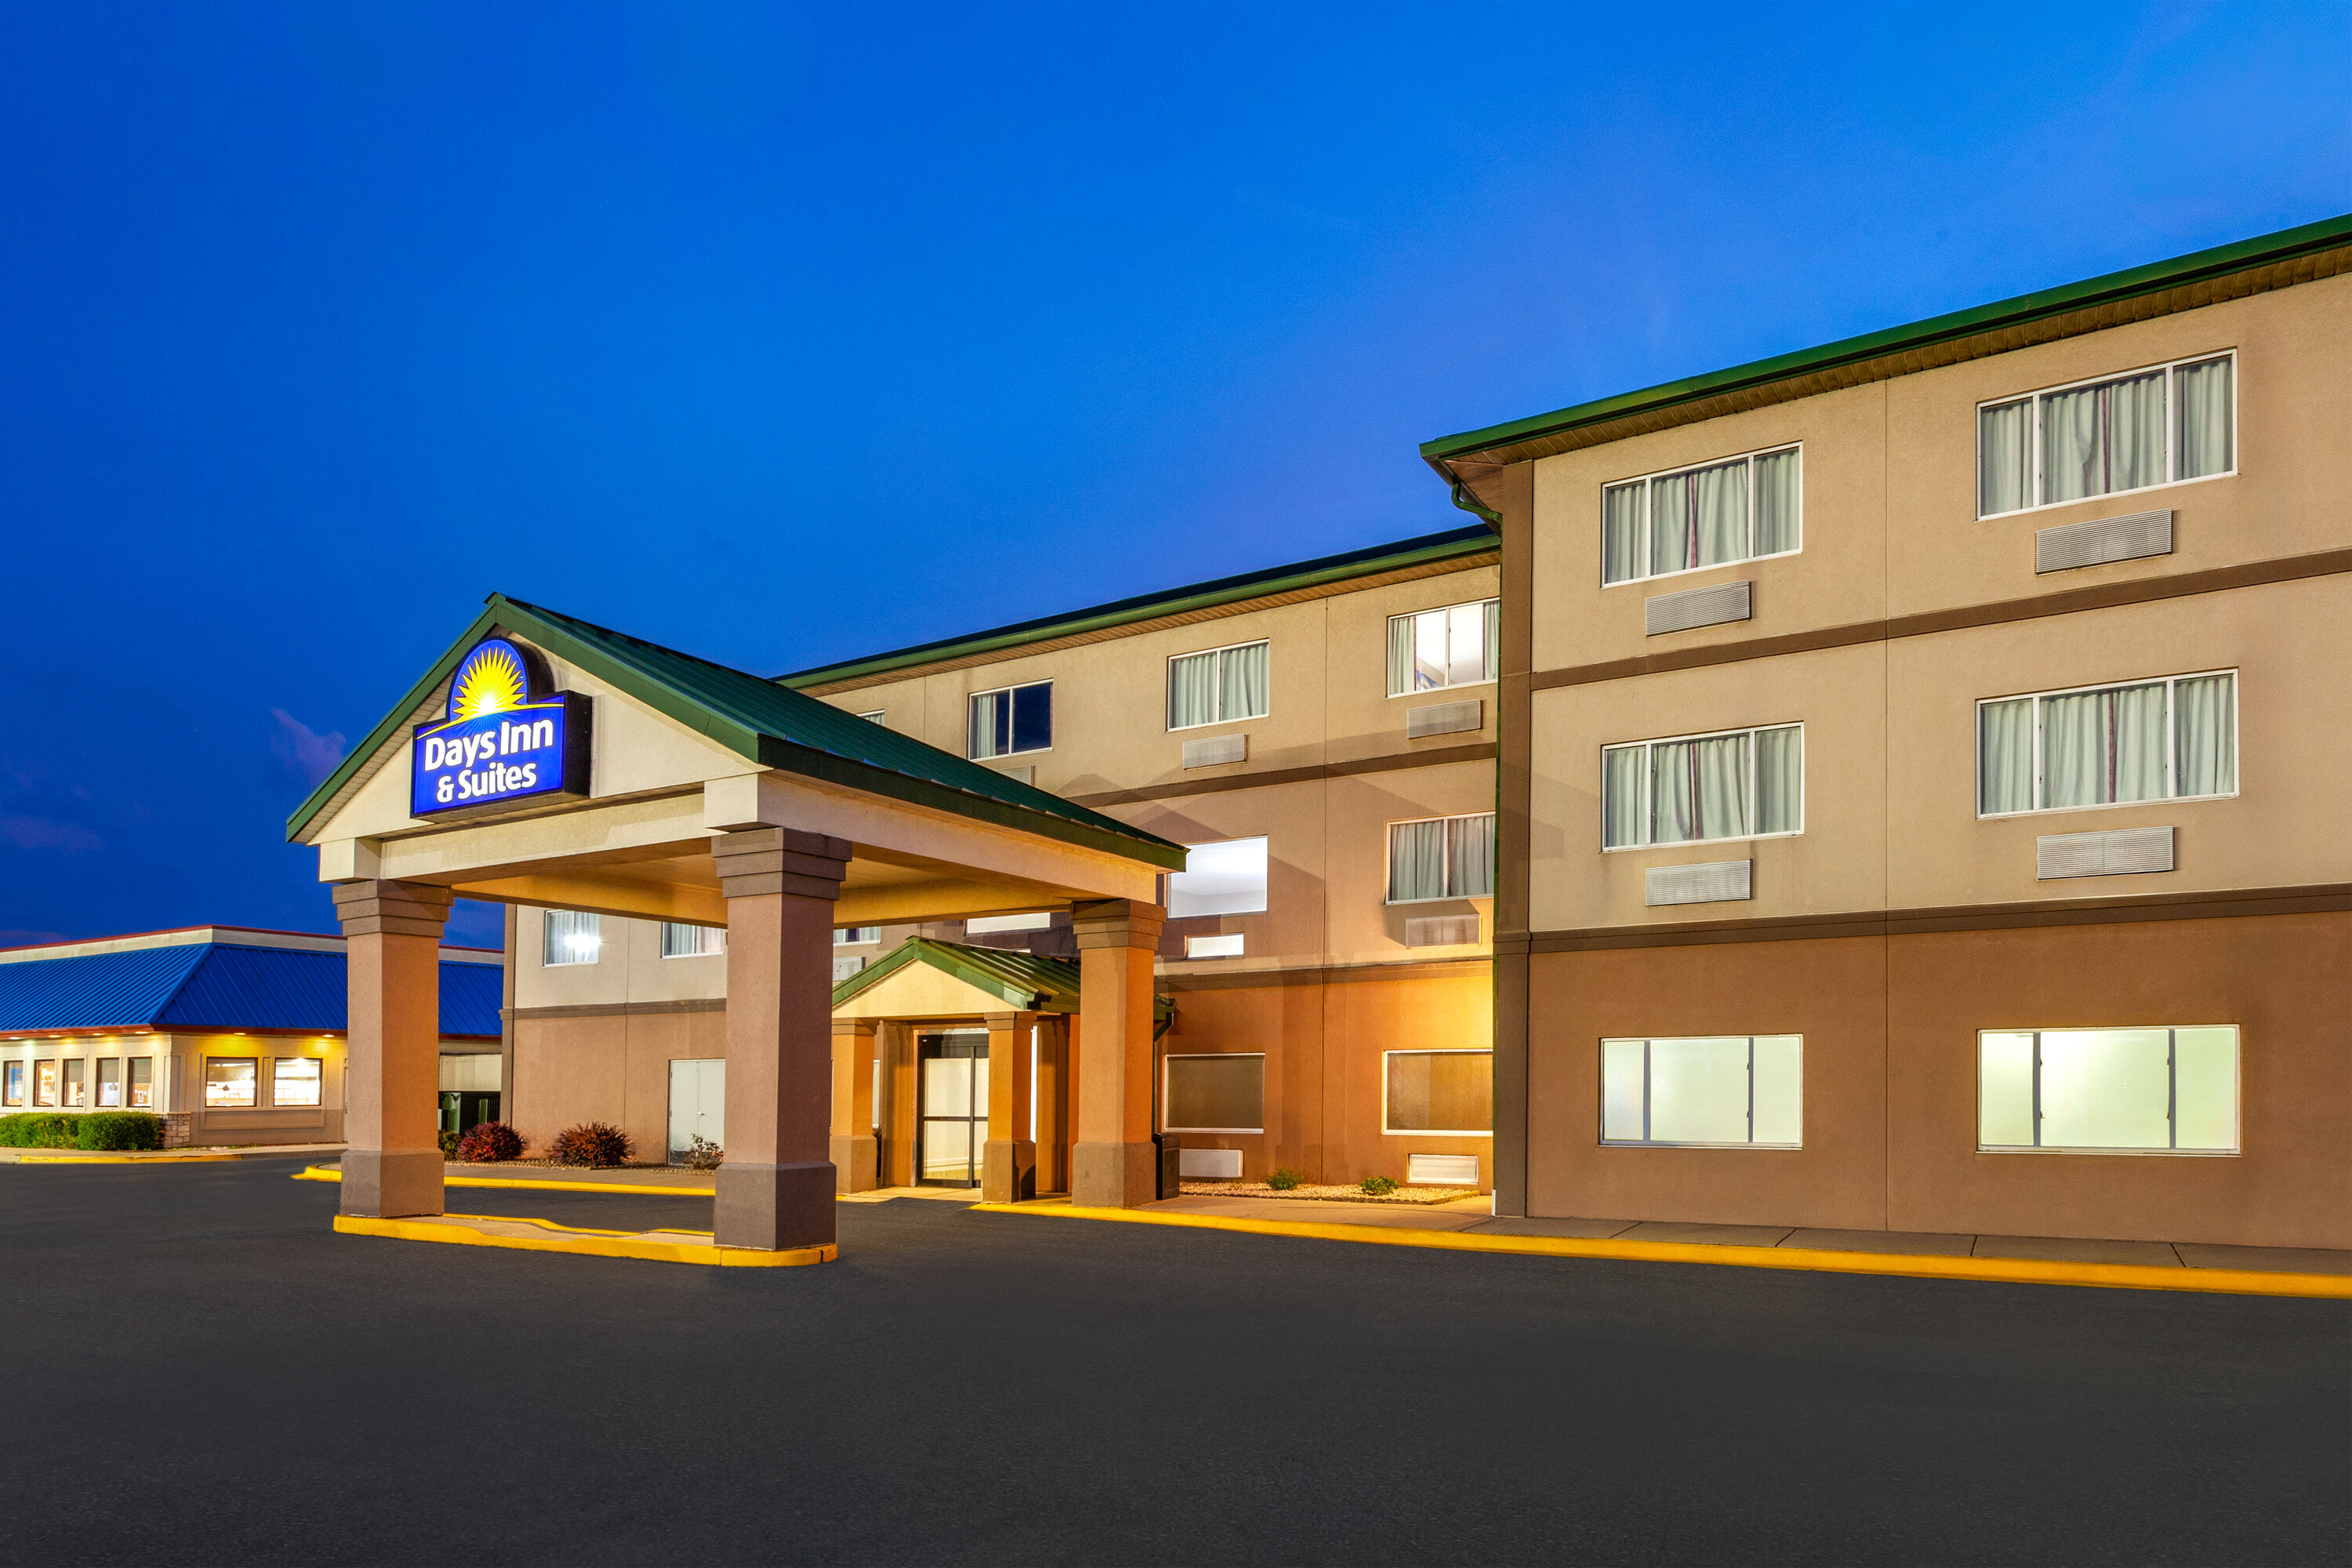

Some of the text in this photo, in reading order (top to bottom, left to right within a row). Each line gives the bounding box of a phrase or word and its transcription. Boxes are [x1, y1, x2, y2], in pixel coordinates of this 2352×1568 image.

[424, 719, 554, 771] Days Inn
[437, 761, 537, 803] & Suites
